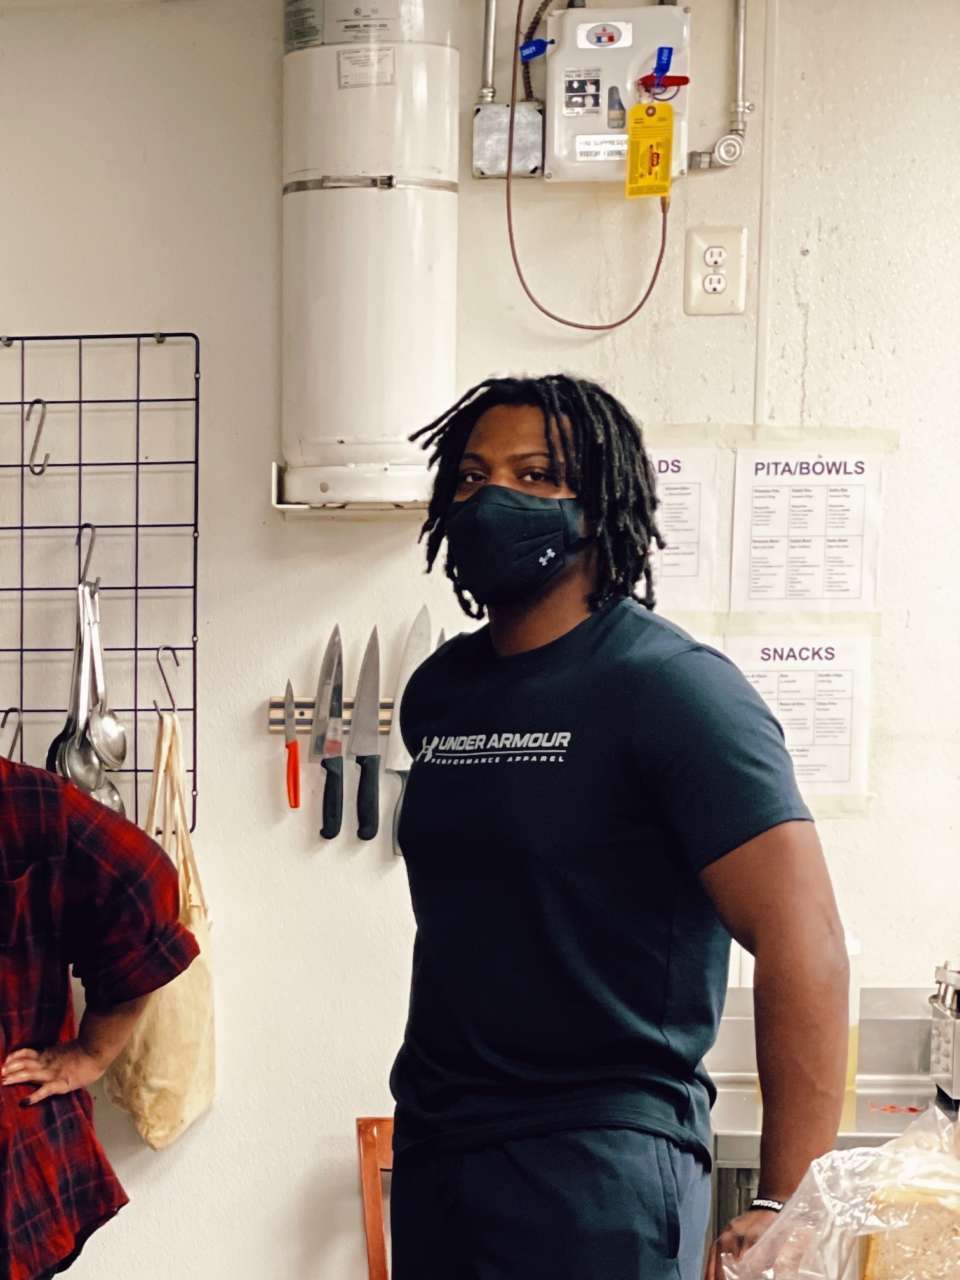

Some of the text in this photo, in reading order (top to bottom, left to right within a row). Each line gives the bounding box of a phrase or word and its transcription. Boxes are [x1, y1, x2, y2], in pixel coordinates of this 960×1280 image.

[655, 459, 682, 474] DS
[753, 460, 866, 477] PITA/BOWLS
[760, 646, 836, 662] SNACKS
[438, 732, 572, 751] UNDER ARMOUR
[431, 755, 565, 765] PERFORMANCE APPAREL
